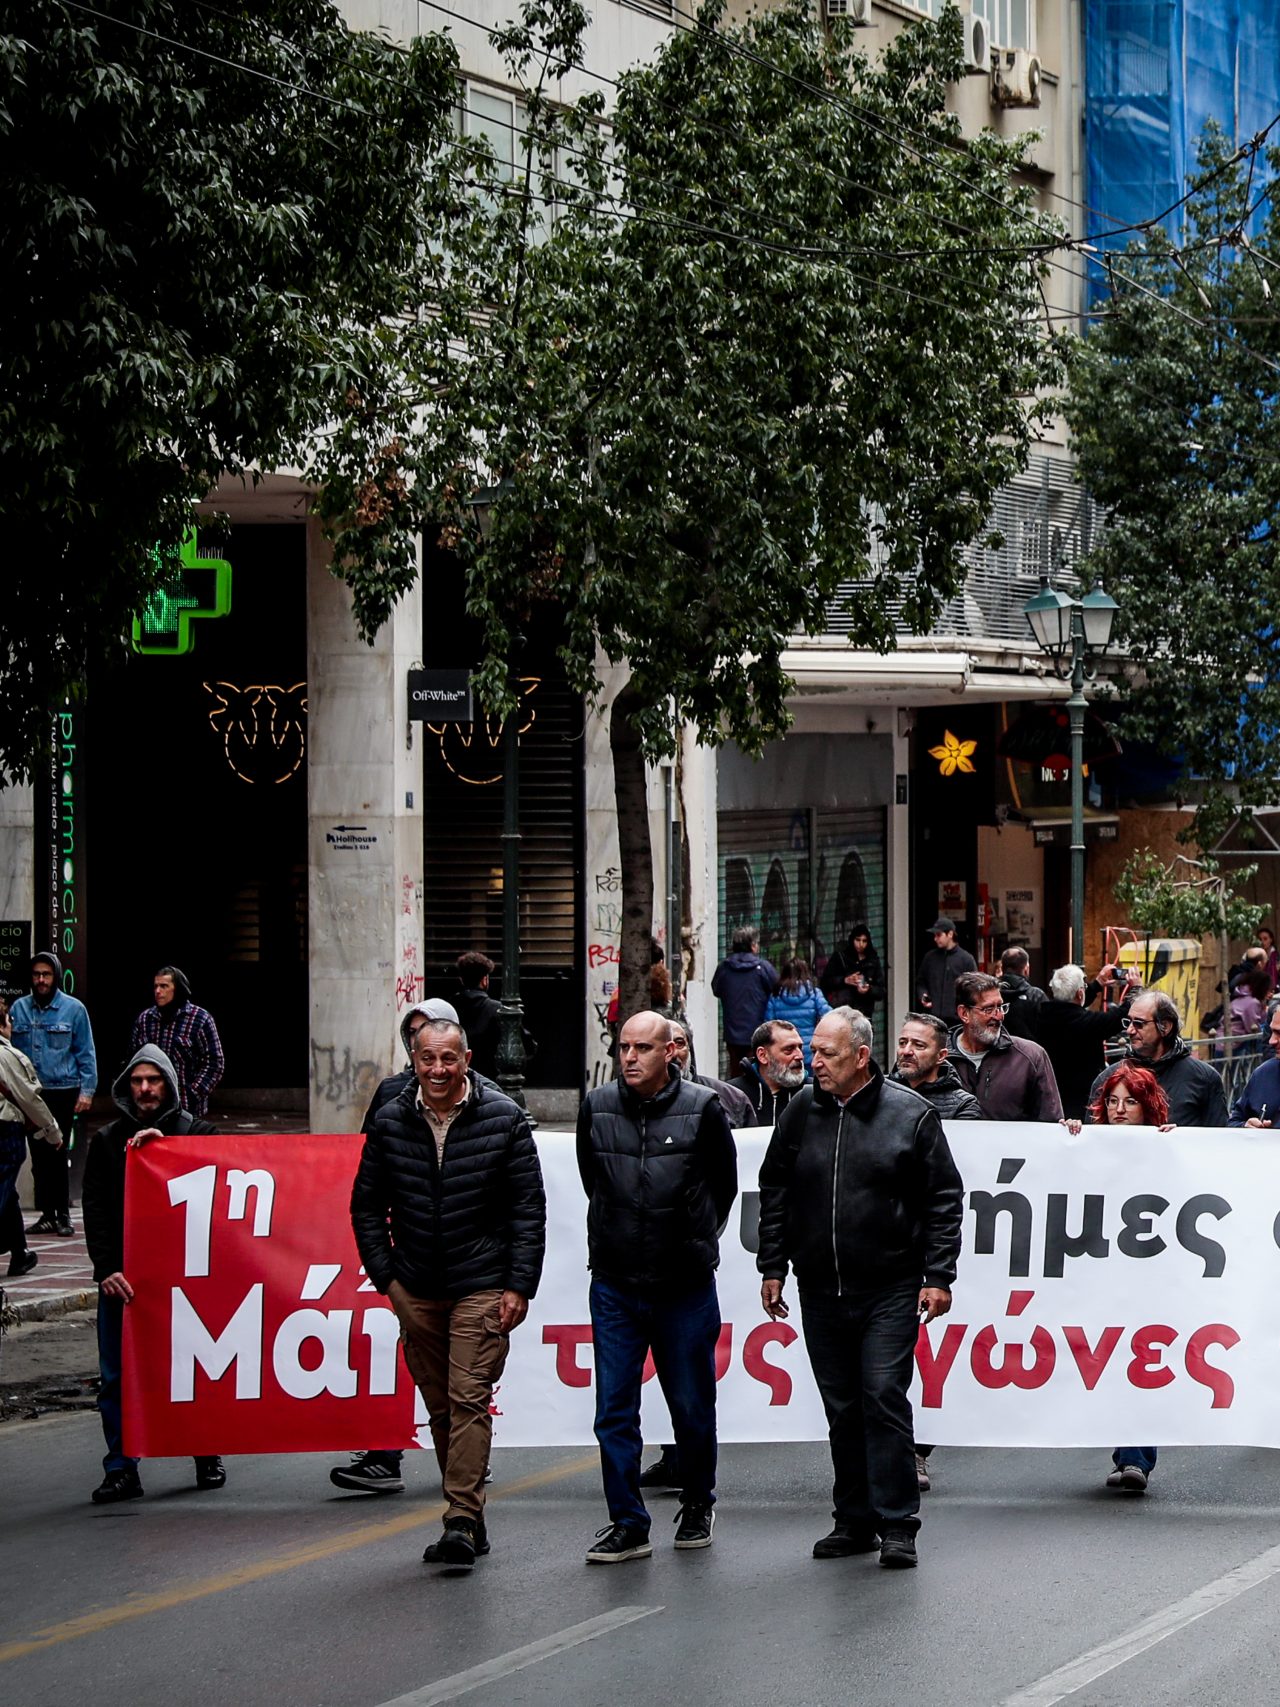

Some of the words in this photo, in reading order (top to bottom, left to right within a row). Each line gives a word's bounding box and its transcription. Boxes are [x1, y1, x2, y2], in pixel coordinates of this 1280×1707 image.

[50, 844, 59, 892] place
[58, 712, 78, 954] pharmacie
[51, 896, 59, 919] de
[166, 1164, 276, 1277] 1η
[963, 1157, 1233, 1279] ήμες
[542, 1321, 799, 1407] τς
[912, 1288, 1242, 1411] γώνες
